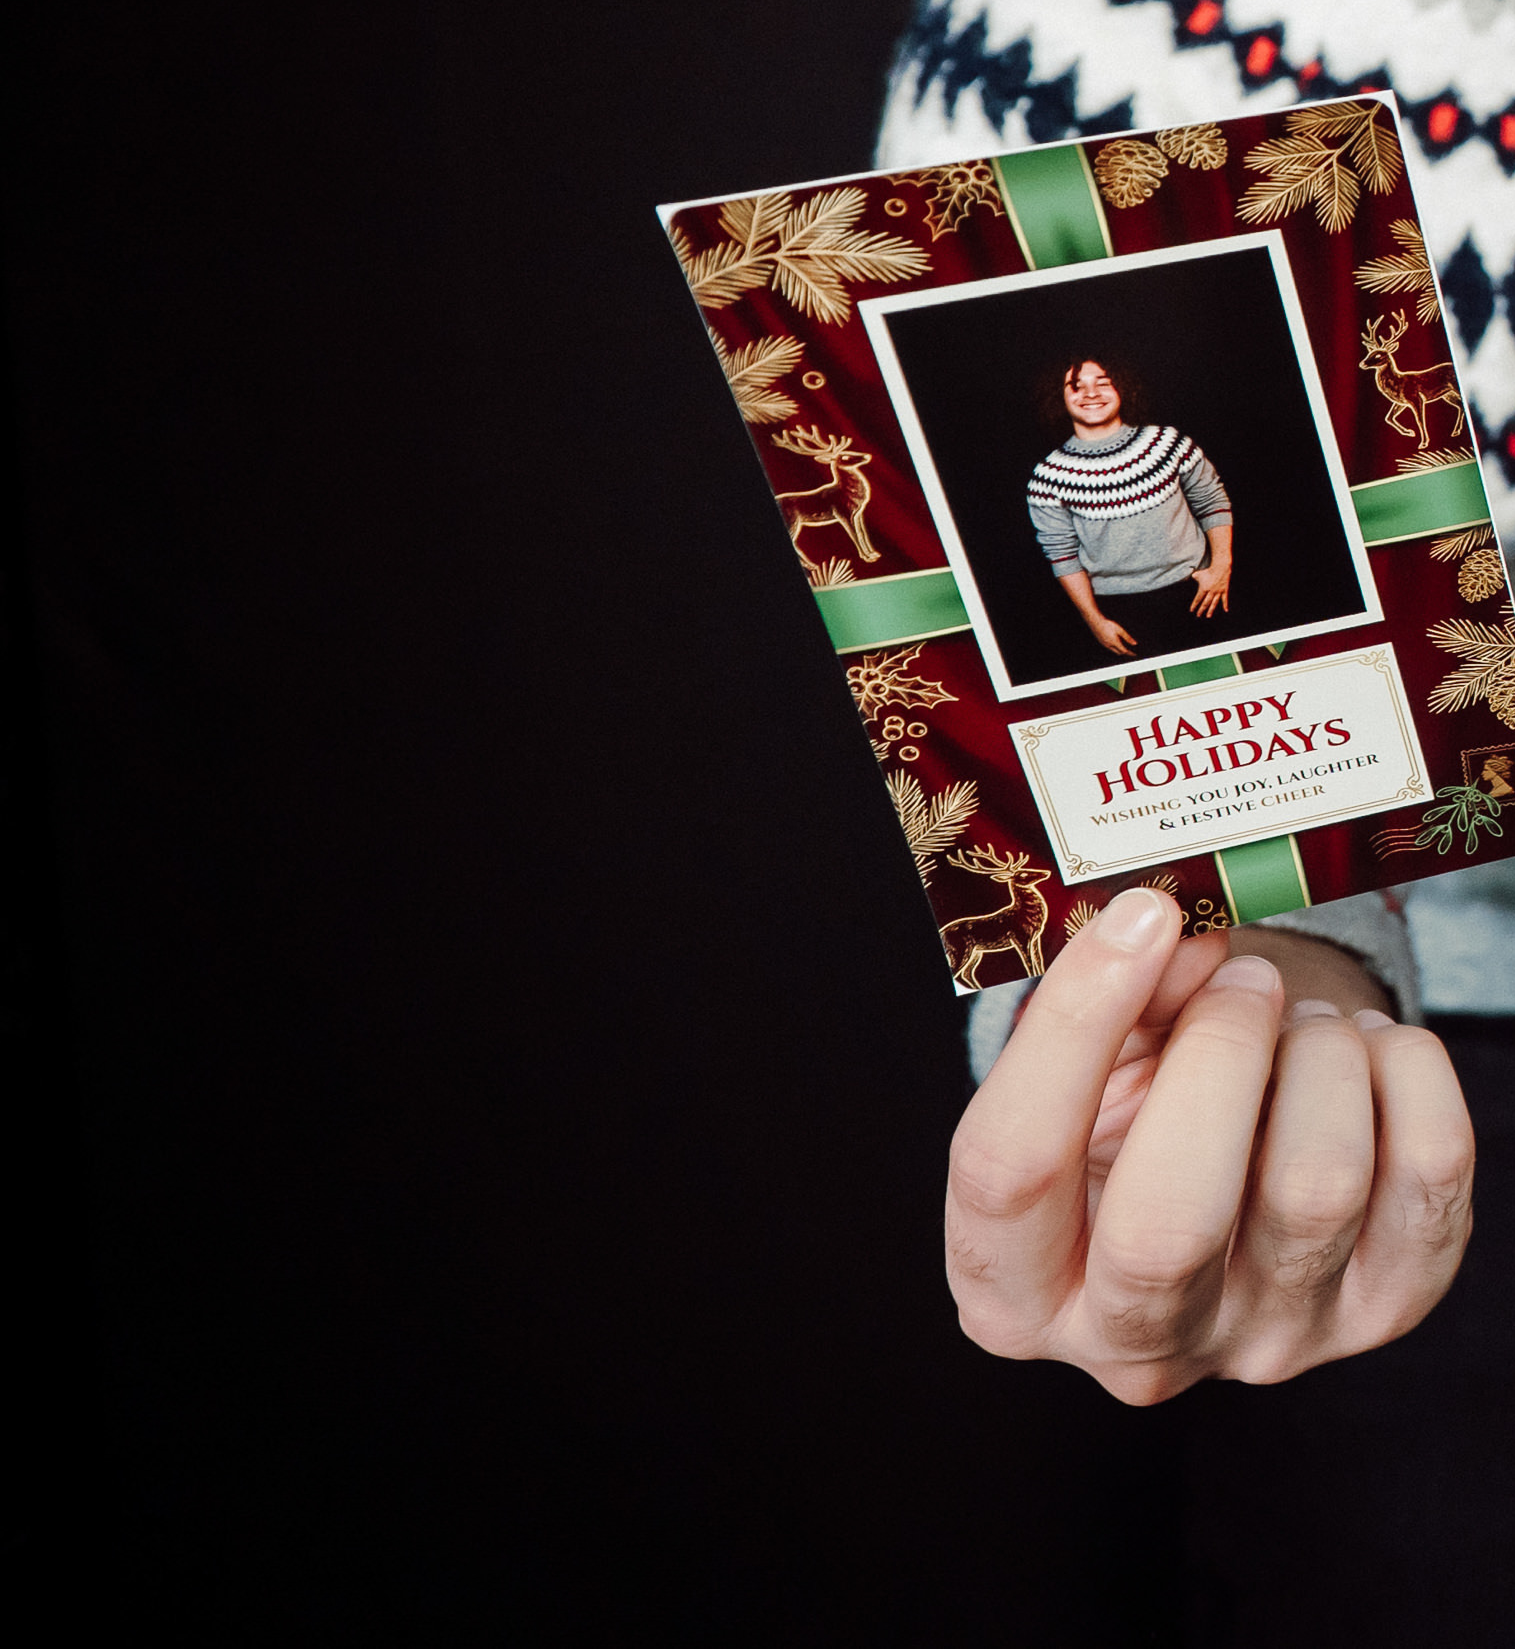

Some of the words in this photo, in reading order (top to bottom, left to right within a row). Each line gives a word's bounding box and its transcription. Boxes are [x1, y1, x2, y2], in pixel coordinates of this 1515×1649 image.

[1125, 691, 1297, 760] HAPPY
[1090, 797, 1182, 827] WISHING
[1185, 786, 1229, 806] YOU
[1234, 778, 1273, 799] JOY,
[1278, 753, 1380, 785] LAUGHTER
[1092, 718, 1352, 805] HOLIDAYS
[1159, 818, 1176, 831] &
[1181, 801, 1257, 827] FESTIVE
[1261, 785, 1325, 807] CHEER
